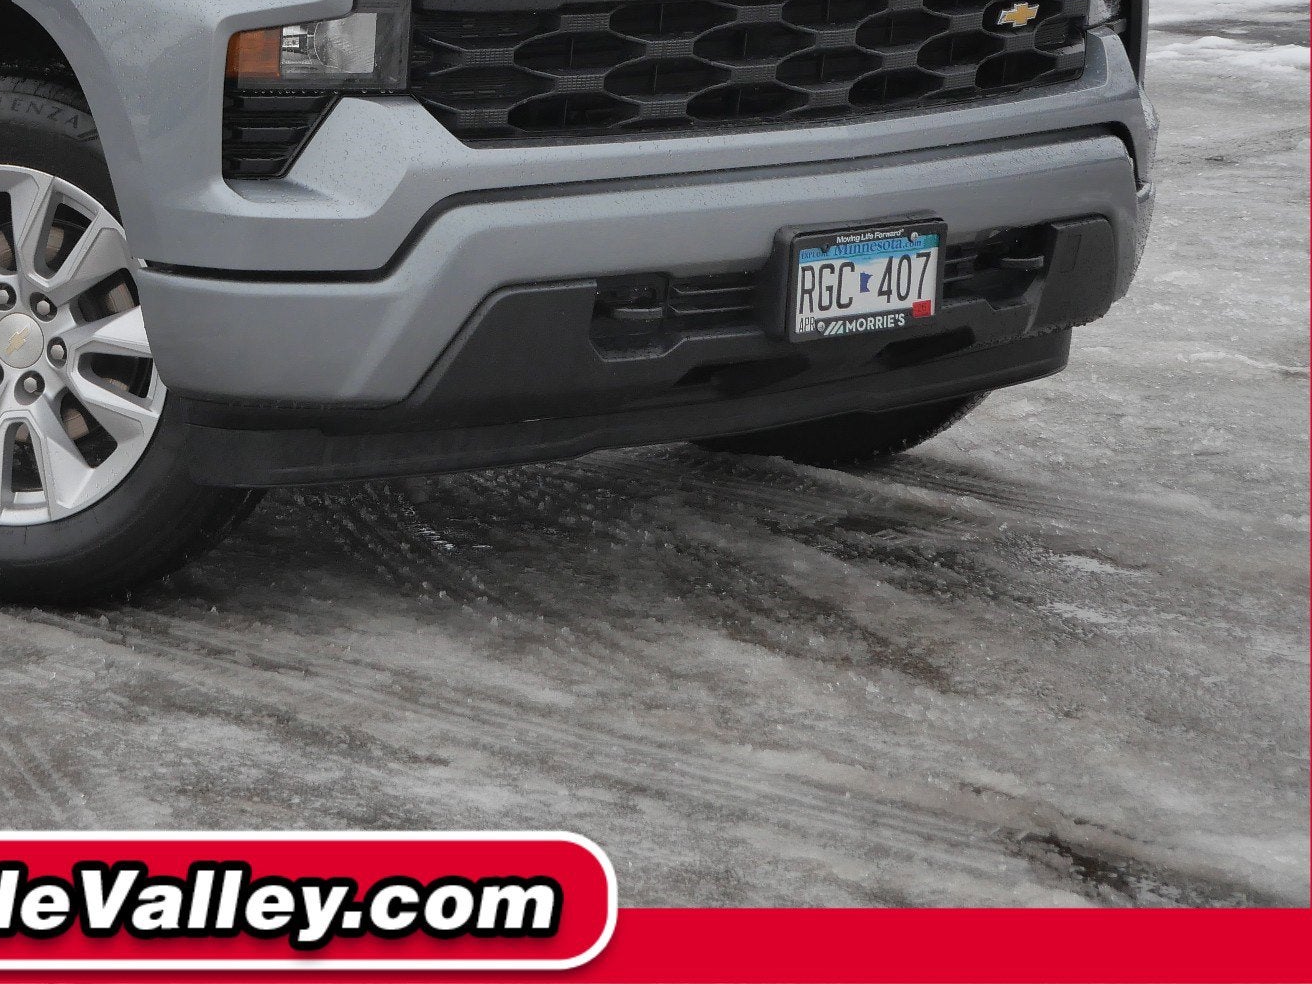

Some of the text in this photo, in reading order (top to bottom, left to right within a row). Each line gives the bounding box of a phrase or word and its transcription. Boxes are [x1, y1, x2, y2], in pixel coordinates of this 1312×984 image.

[836, 235, 861, 244] Moving
[798, 251, 932, 315] RGC 407
[845, 313, 906, 333] MORRIE'S
